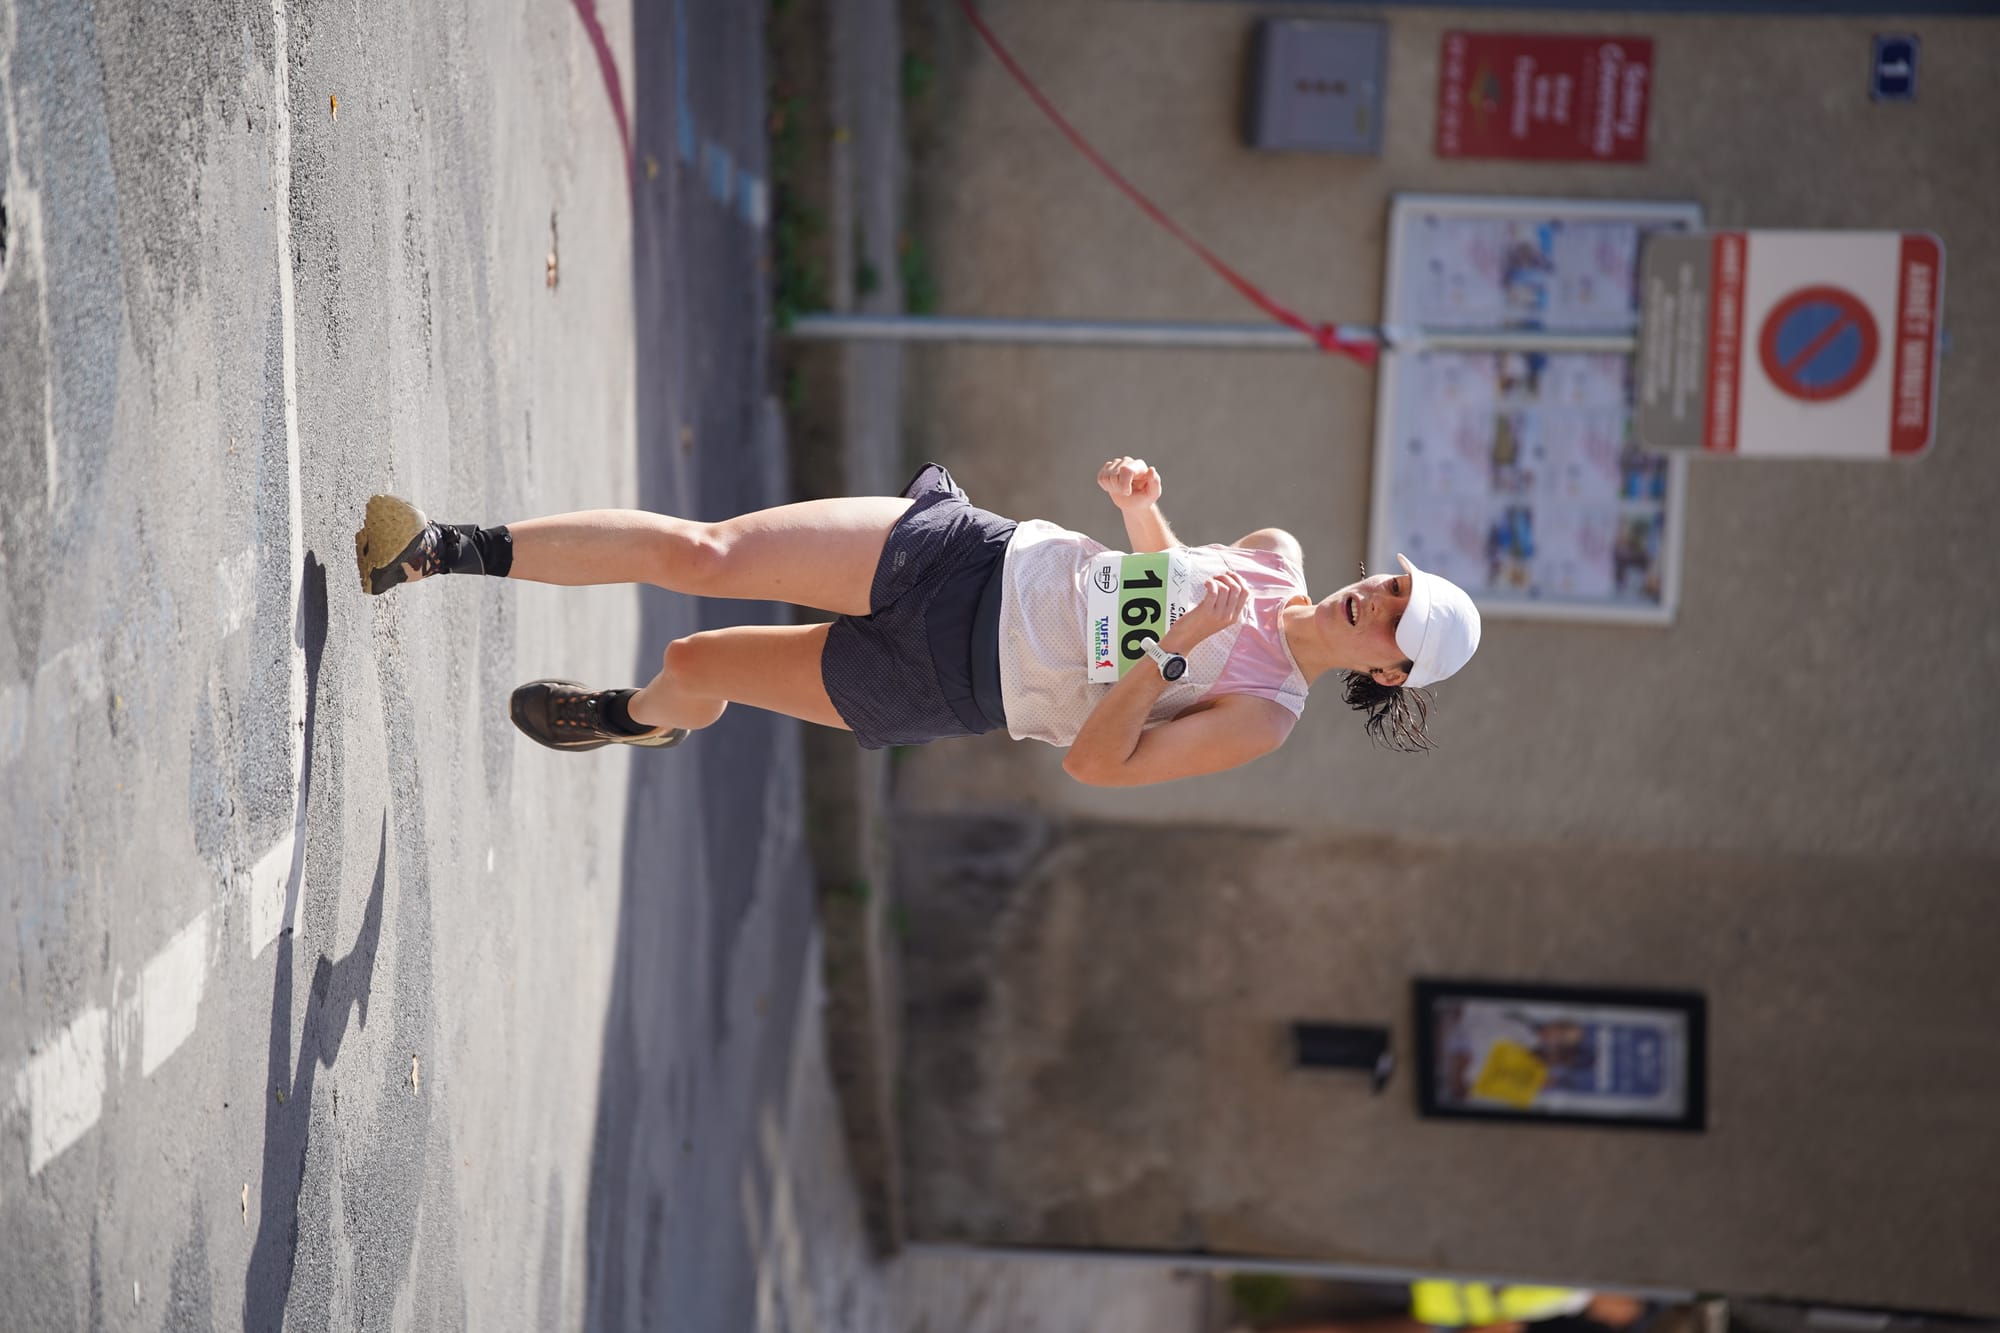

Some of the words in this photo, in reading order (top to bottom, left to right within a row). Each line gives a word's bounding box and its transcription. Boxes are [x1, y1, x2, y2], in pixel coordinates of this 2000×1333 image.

[1880, 58, 1909, 77] 1
[1101, 566, 1111, 590] BFP
[1121, 570, 1163, 660] 166
[1095, 620, 1103, 661] Aventure
[1101, 616, 1109, 656] TUFF'S
